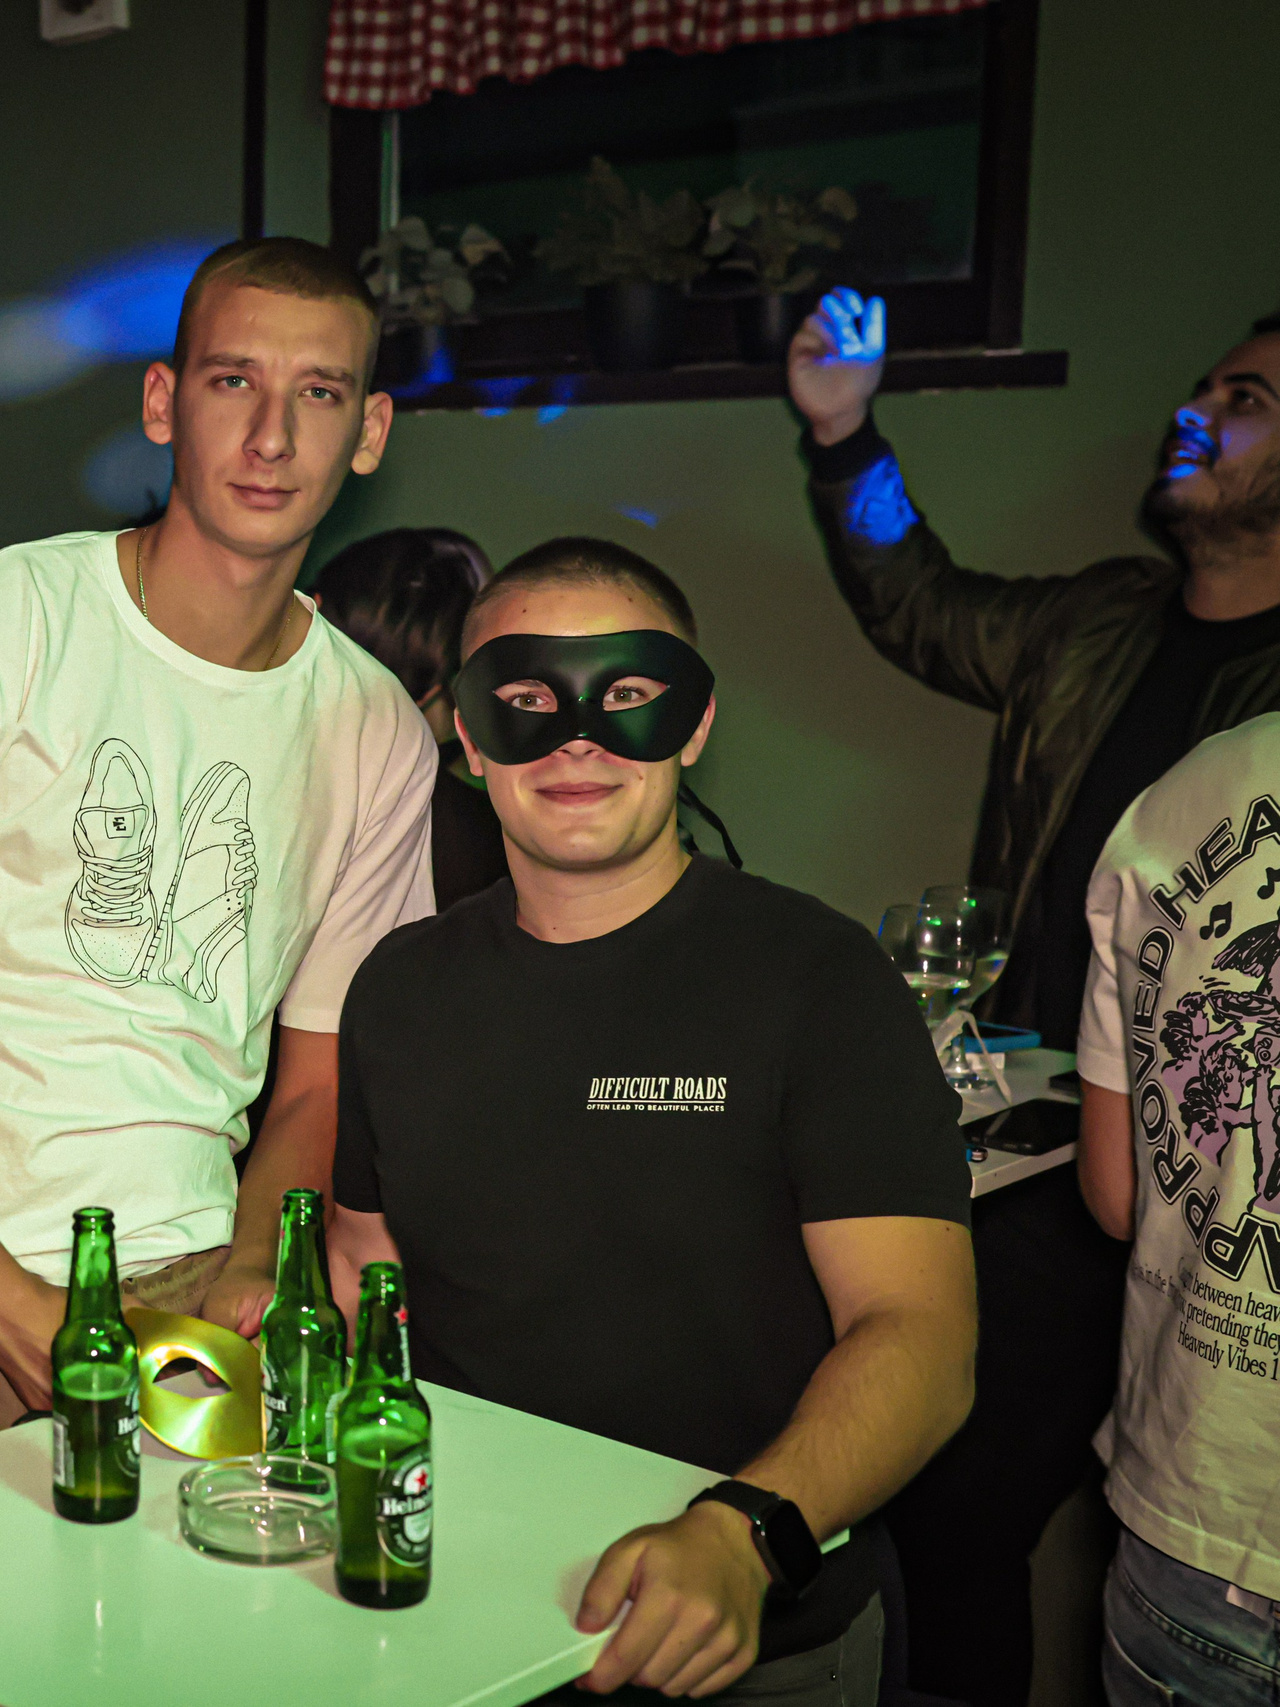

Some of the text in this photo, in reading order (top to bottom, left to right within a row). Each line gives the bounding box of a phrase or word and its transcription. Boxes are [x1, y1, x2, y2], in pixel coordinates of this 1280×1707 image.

[586, 1103, 610, 1111] OFTEN
[647, 1104, 690, 1112] BEAUTIFUL
[589, 1077, 727, 1100] DIFFICULT ROADS
[1192, 1272, 1243, 1313] between
[1186, 1302, 1253, 1347] pretending
[1177, 1320, 1225, 1369] Heavenly
[1227, 1343, 1267, 1378] Vibes
